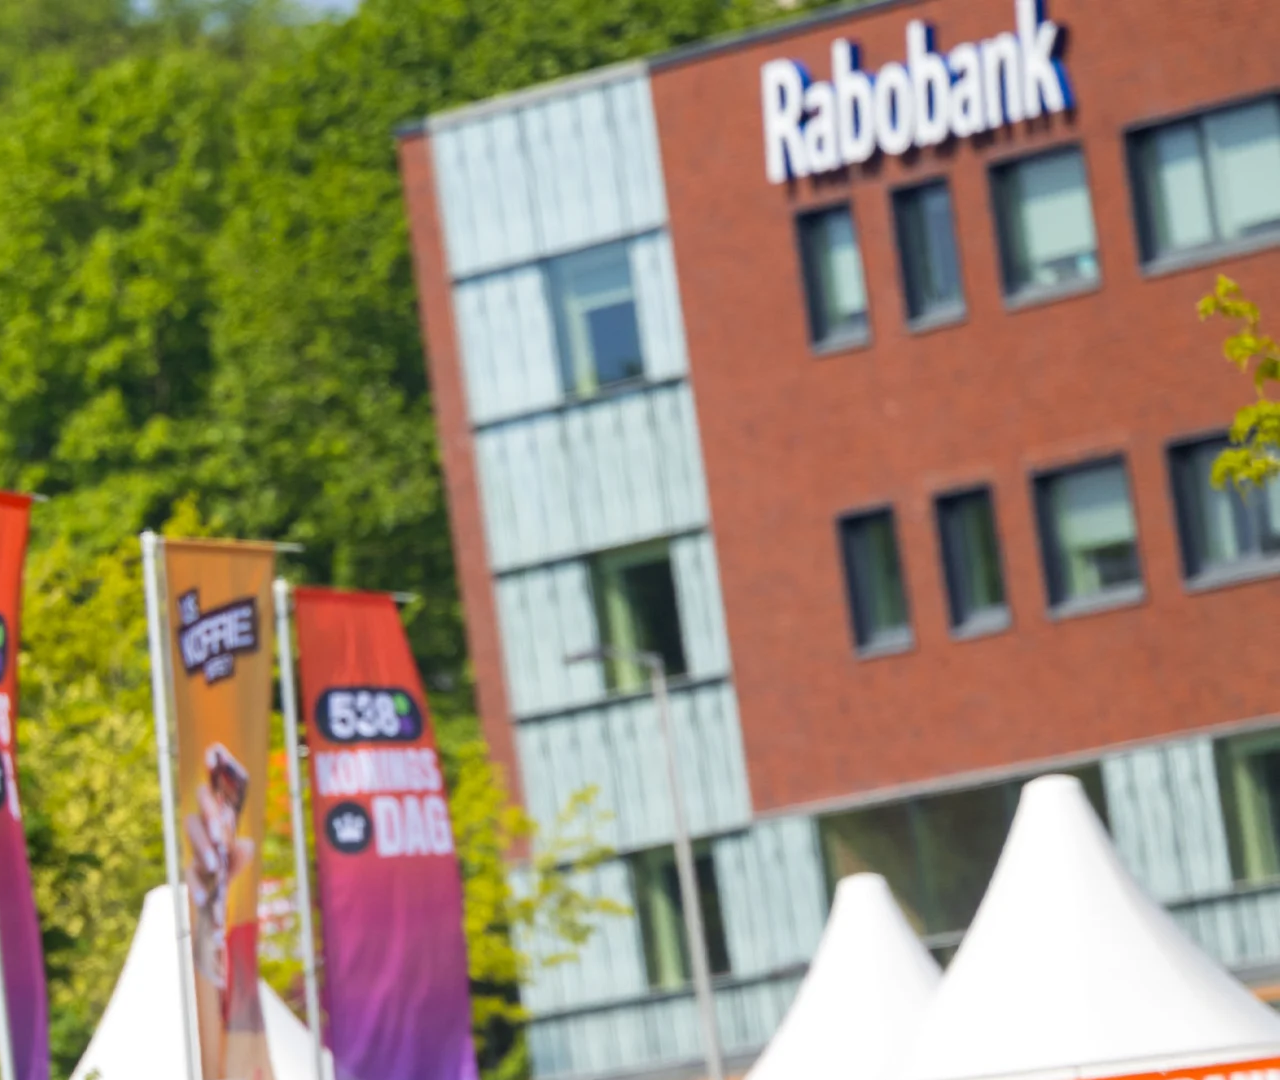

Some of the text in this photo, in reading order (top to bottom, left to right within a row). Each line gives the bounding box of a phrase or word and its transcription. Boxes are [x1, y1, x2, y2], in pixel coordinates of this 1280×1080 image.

[760, 0, 1072, 184] Rabobank
[328, 690, 401, 740] 538
[314, 747, 443, 796] KONINGS
[371, 796, 454, 858] DAG
